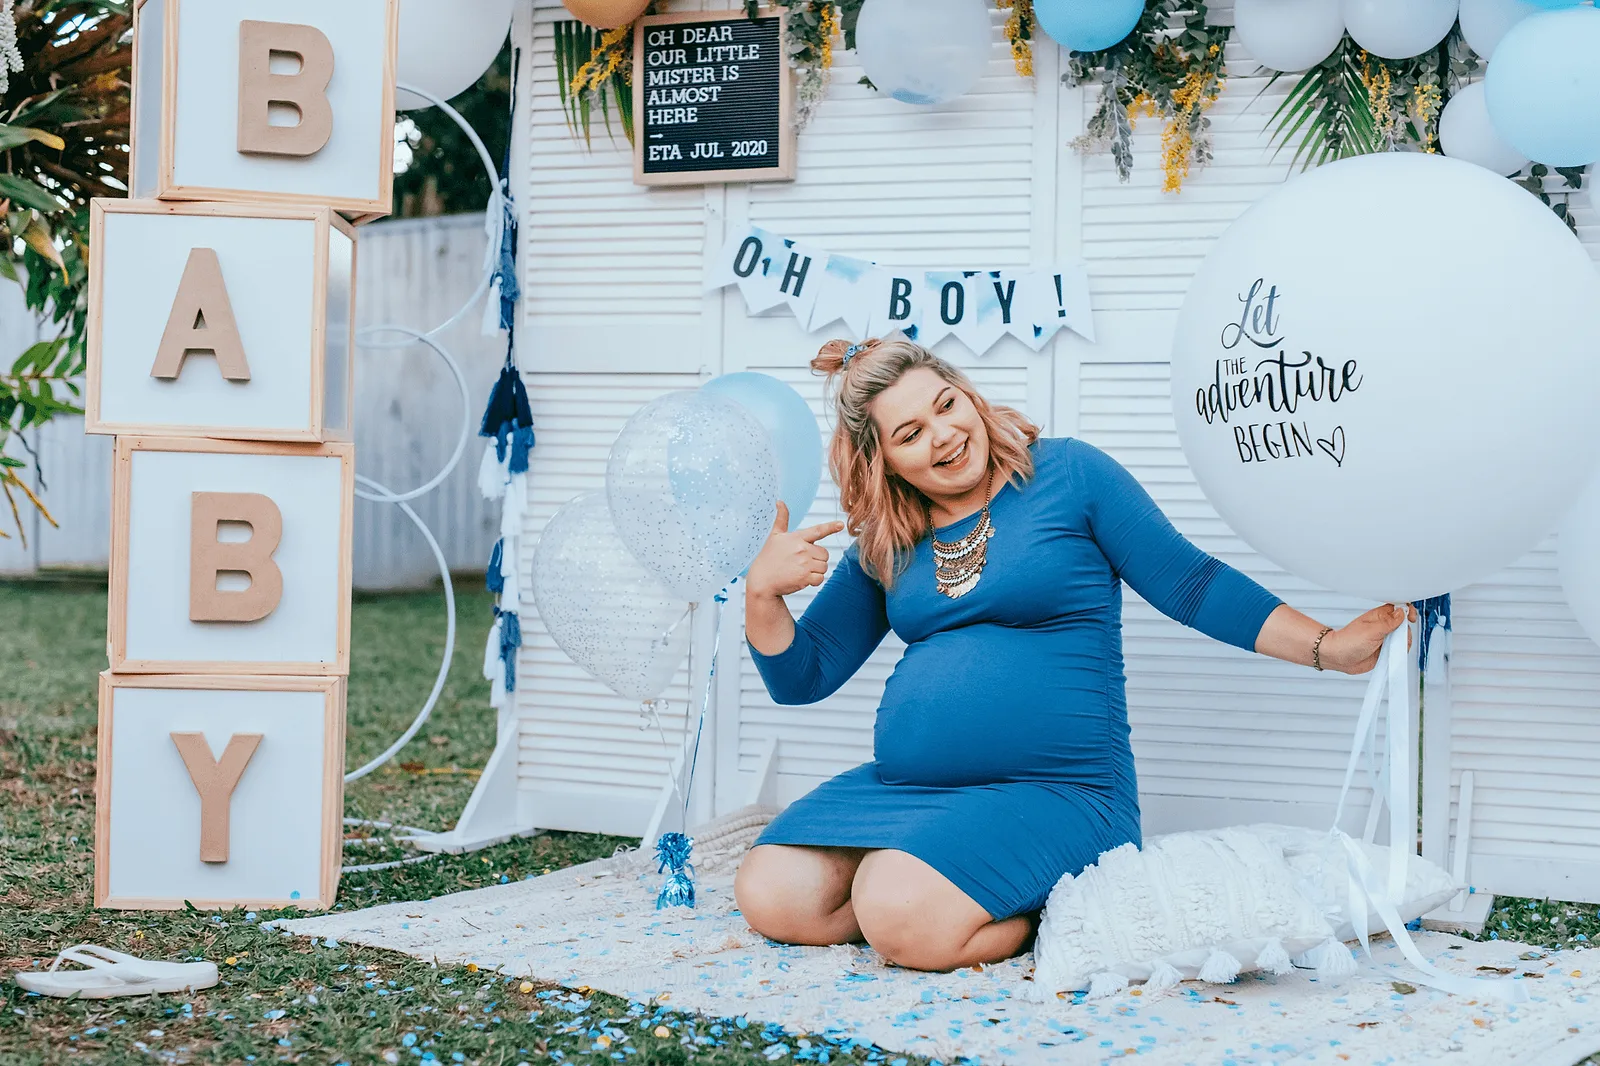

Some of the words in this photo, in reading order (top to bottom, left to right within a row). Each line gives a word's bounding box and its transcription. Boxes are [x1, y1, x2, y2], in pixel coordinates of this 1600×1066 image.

[648, 30, 674, 46] OH
[683, 26, 733, 43] DEAR
[648, 49, 687, 66] OUR
[696, 44, 760, 63] LITTLE
[648, 67, 715, 86] MISTER
[722, 65, 739, 81] IS
[647, 86, 721, 106] ALMOST
[648, 107, 698, 125] HERE
[649, 144, 682, 161] ETA
[690, 142, 724, 158] JUL
[731, 140, 767, 157] 2020
[733, 236, 812, 298] OH
[1221, 278, 1285, 349] Let
[1223, 357, 1247, 376] THE
[1196, 350, 1363, 424] adventure
[1233, 421, 1313, 463] BEGIN
